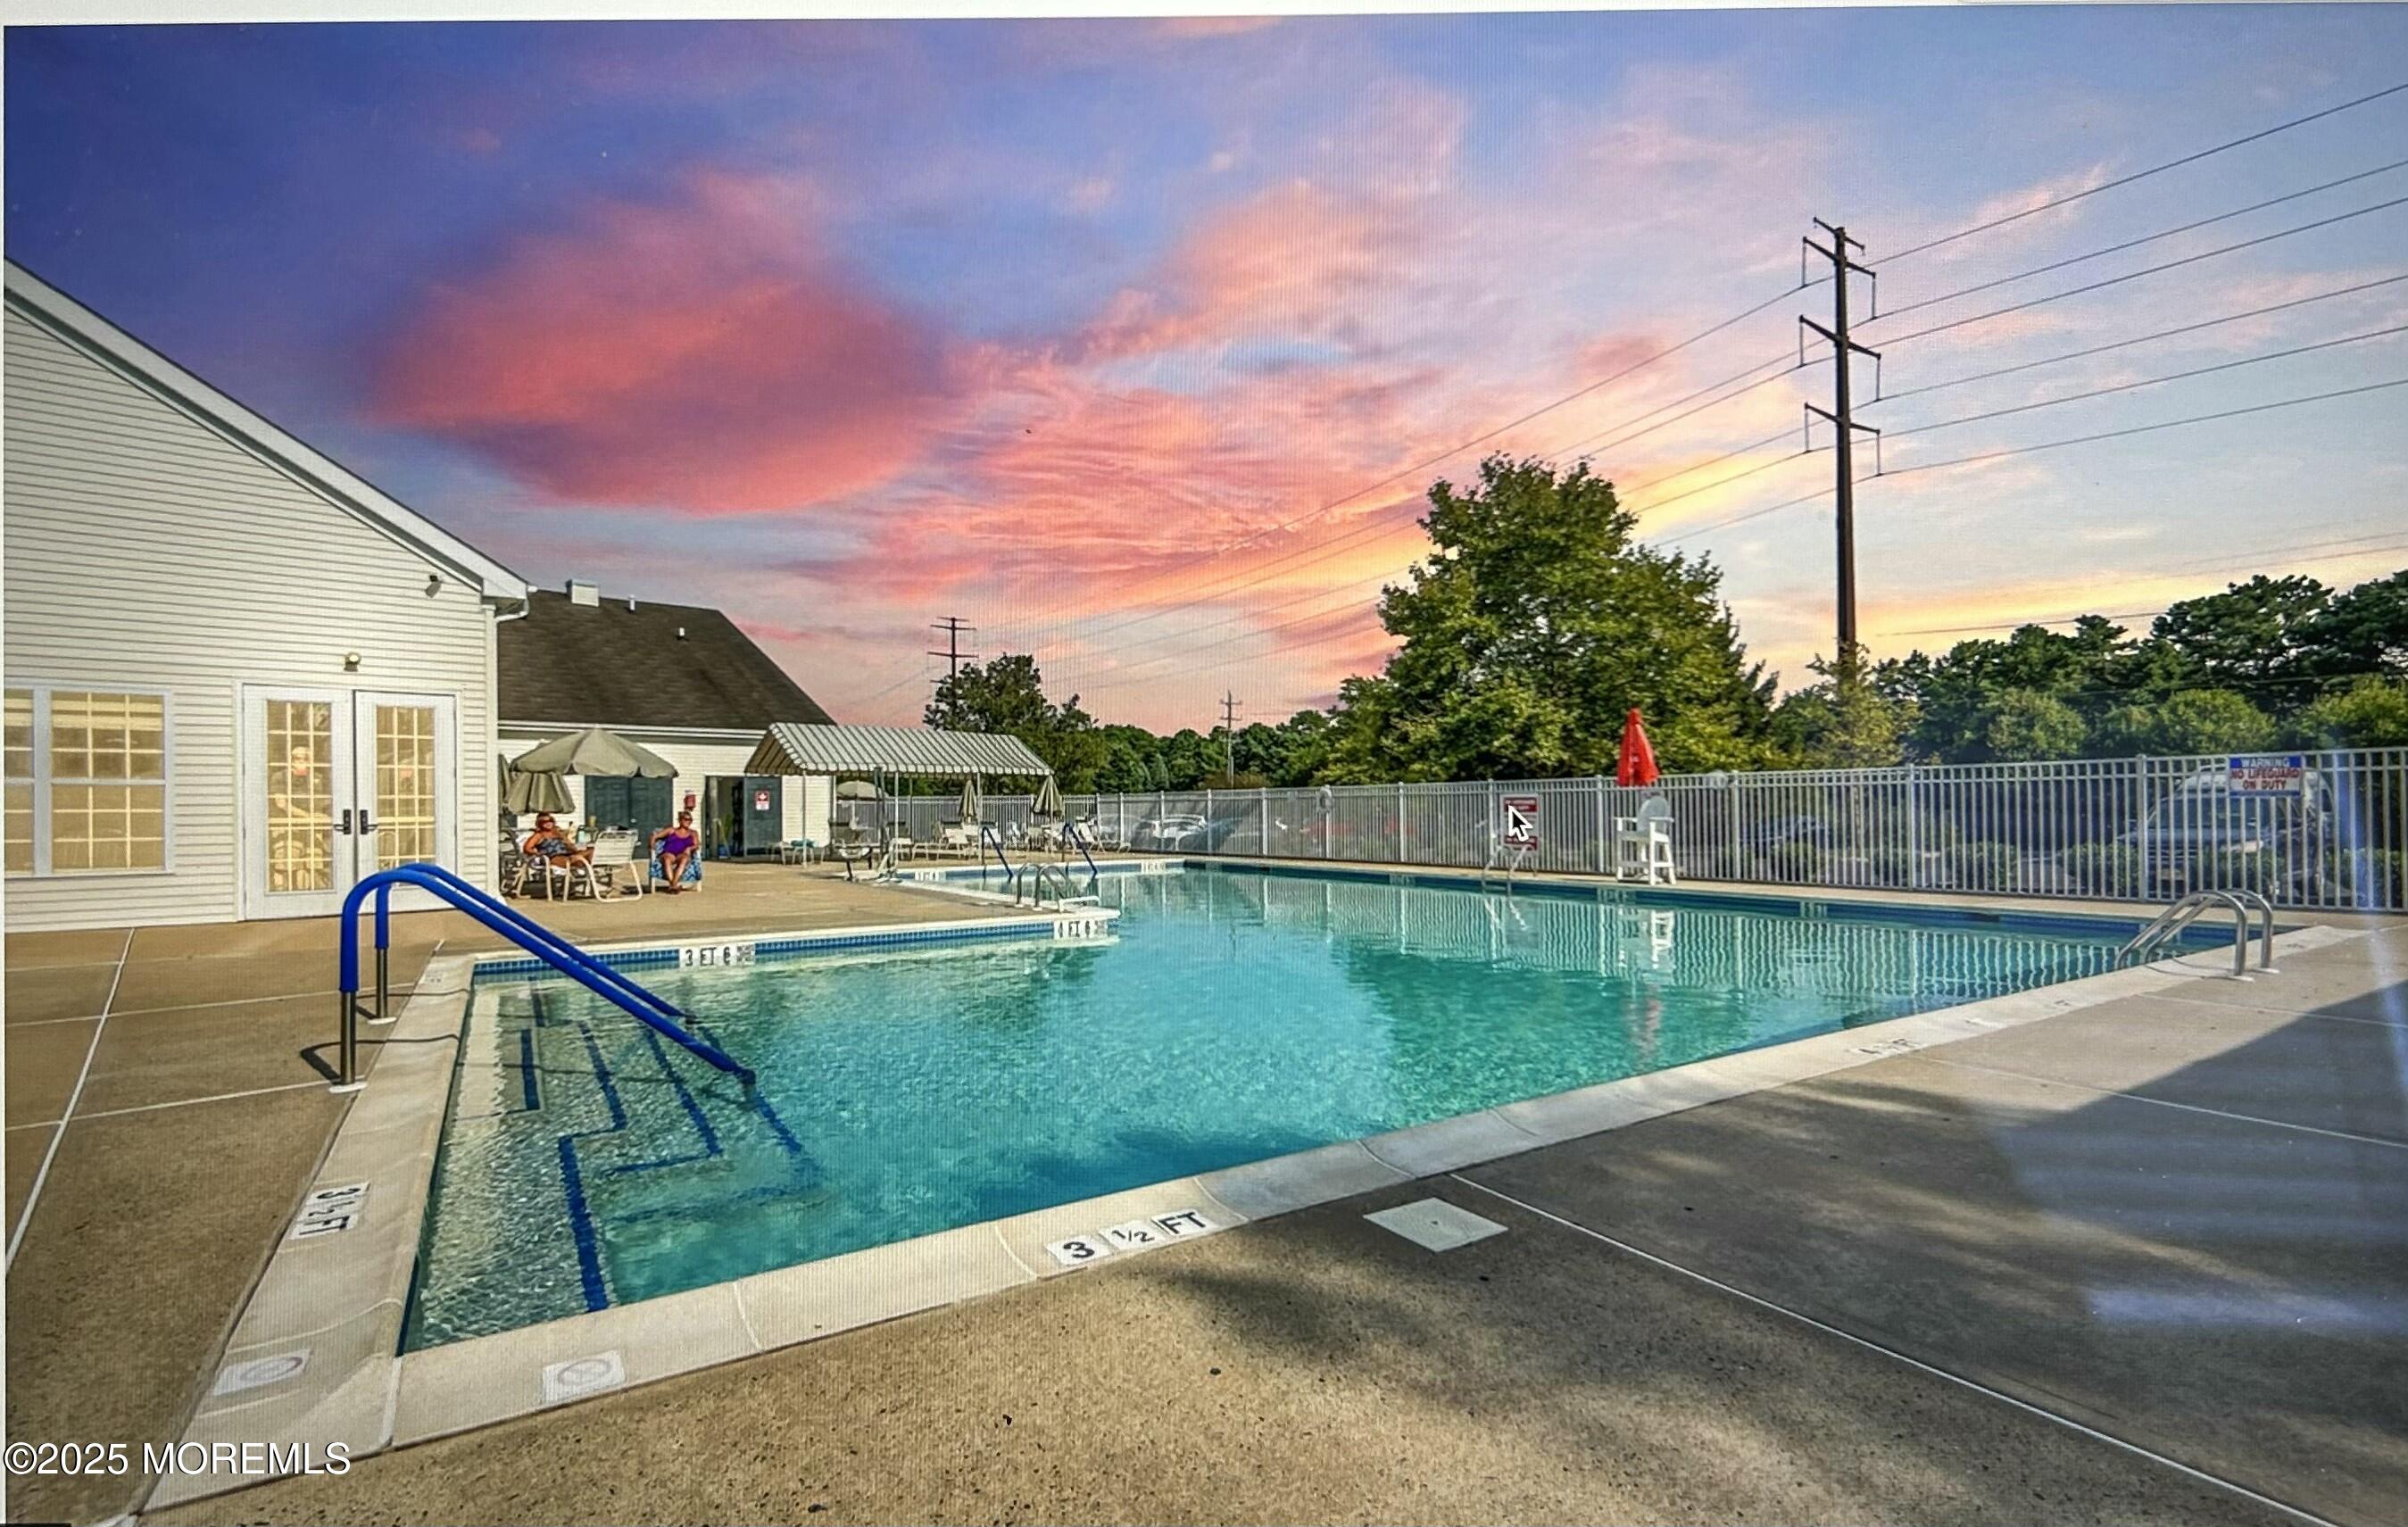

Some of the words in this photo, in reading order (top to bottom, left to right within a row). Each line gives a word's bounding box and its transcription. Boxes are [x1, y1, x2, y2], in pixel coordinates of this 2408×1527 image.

[2241, 758, 2290, 768] WARNING
[2232, 768, 2245, 779] NO
[2248, 768, 2300, 779] LIFEGUARD
[2243, 779, 2256, 790] ON
[2262, 779, 2287, 790] DUTY
[1063, 1241, 1095, 1259] 3
[1158, 1211, 1208, 1235] FT
